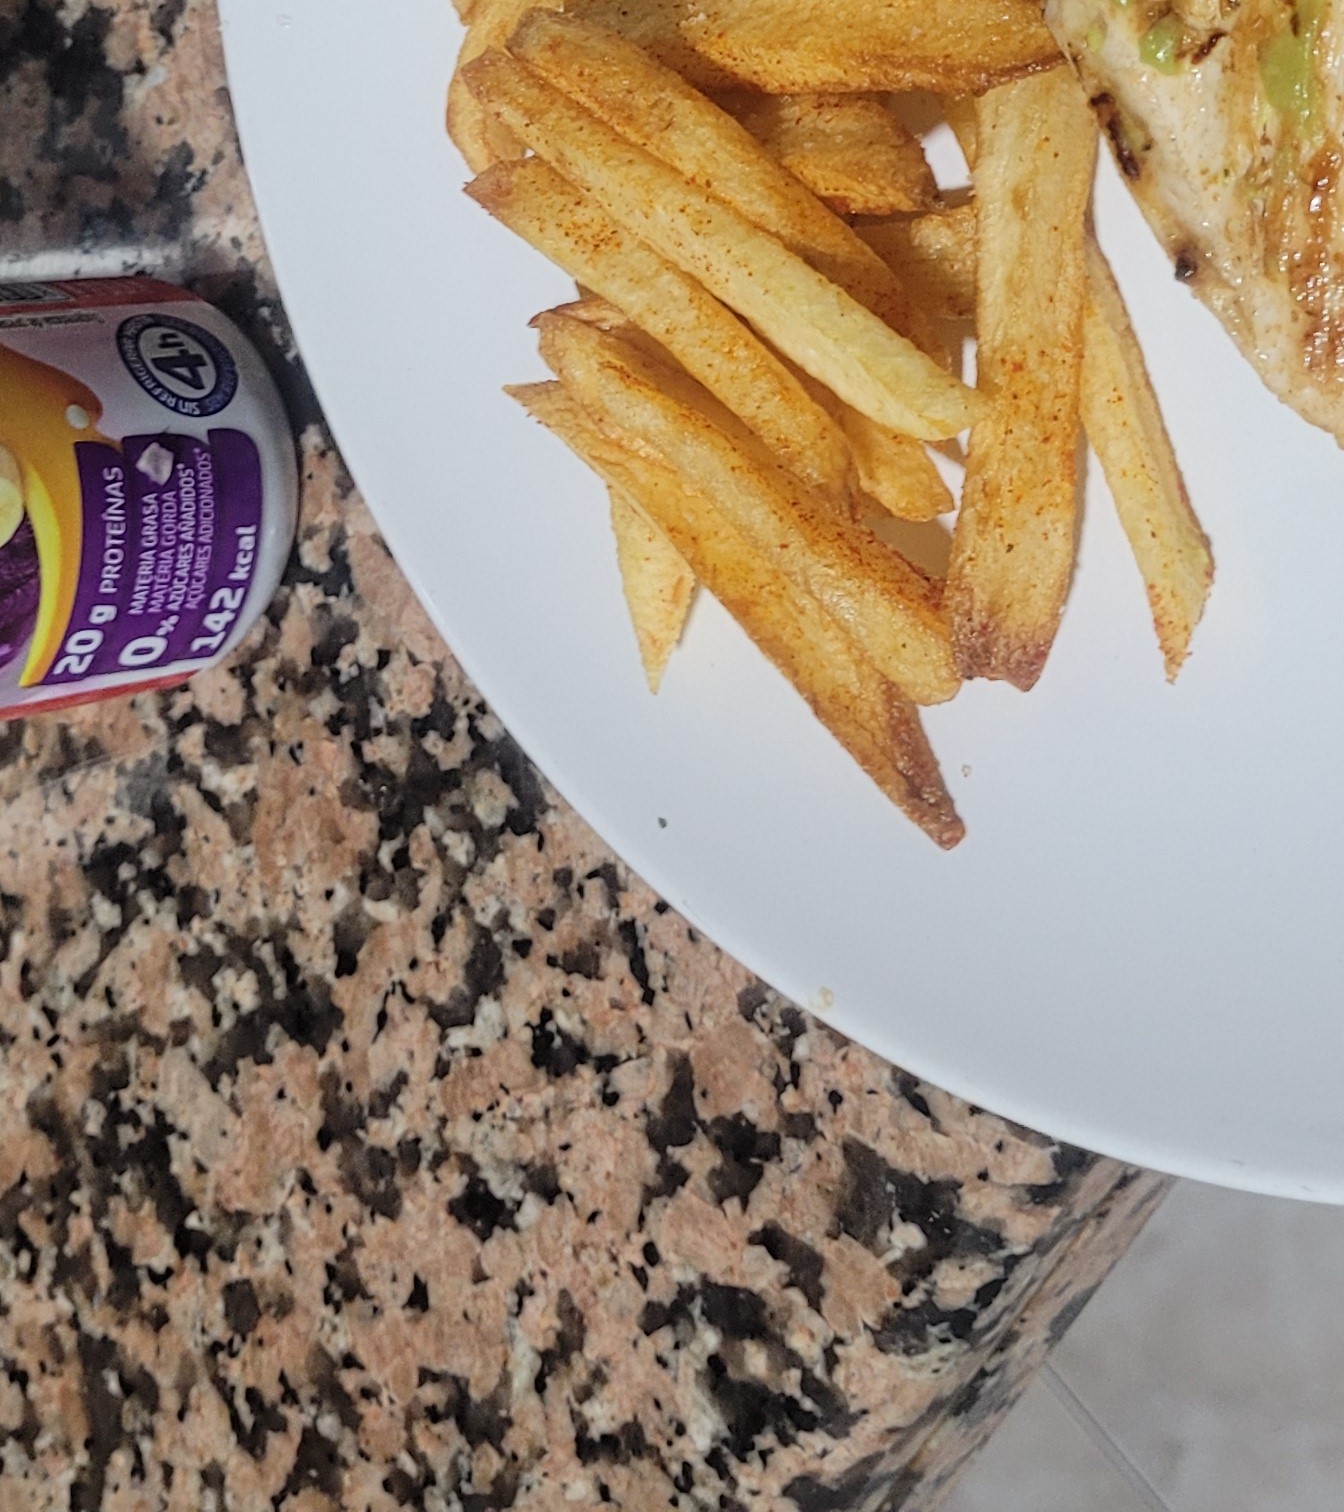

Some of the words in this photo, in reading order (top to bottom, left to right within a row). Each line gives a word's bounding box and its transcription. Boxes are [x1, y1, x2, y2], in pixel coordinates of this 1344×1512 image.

[99, 466, 126, 594] PROTEÍNAS
[141, 493, 159, 548] GRASA
[160, 491, 178, 547] GORDA
[128, 550, 156, 615] MATERIA
[147, 549, 175, 614] MATÉRIA
[167, 543, 194, 612] AZÚCARES
[191, 586, 246, 653] 142
[228, 524, 257, 581] kcal
[89, 604, 117, 625] g
[52, 629, 104, 676] 20
